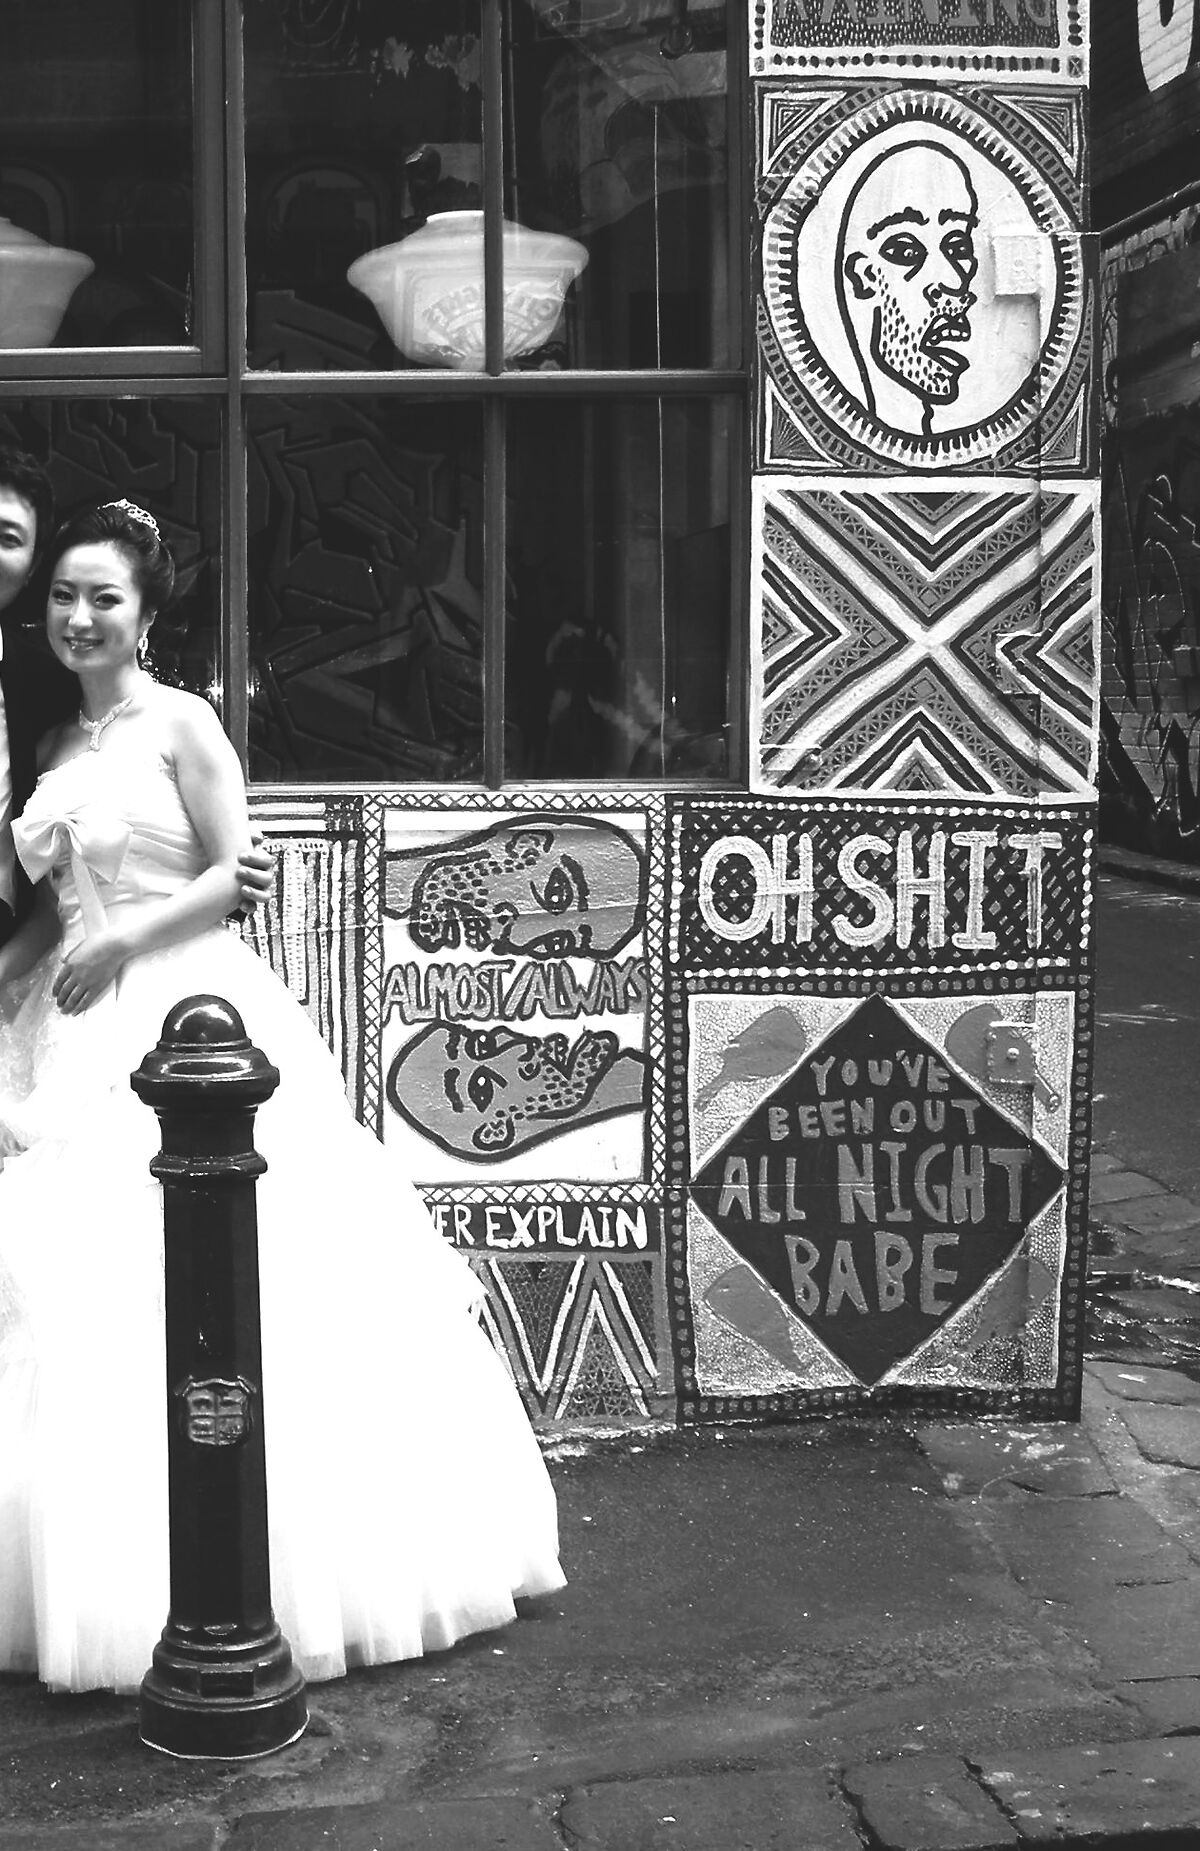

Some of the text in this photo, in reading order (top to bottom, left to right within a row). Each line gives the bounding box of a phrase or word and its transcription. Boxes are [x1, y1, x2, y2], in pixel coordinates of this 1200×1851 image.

[699, 831, 1062, 950] OH SHIT
[810, 1050, 950, 1096] YOU'VE
[768, 1098, 981, 1140] BEEN OUT
[717, 1142, 1031, 1224] ALL NIGHT
[485, 1204, 648, 1250] EXPLAIN
[784, 1231, 959, 1316] BABE
